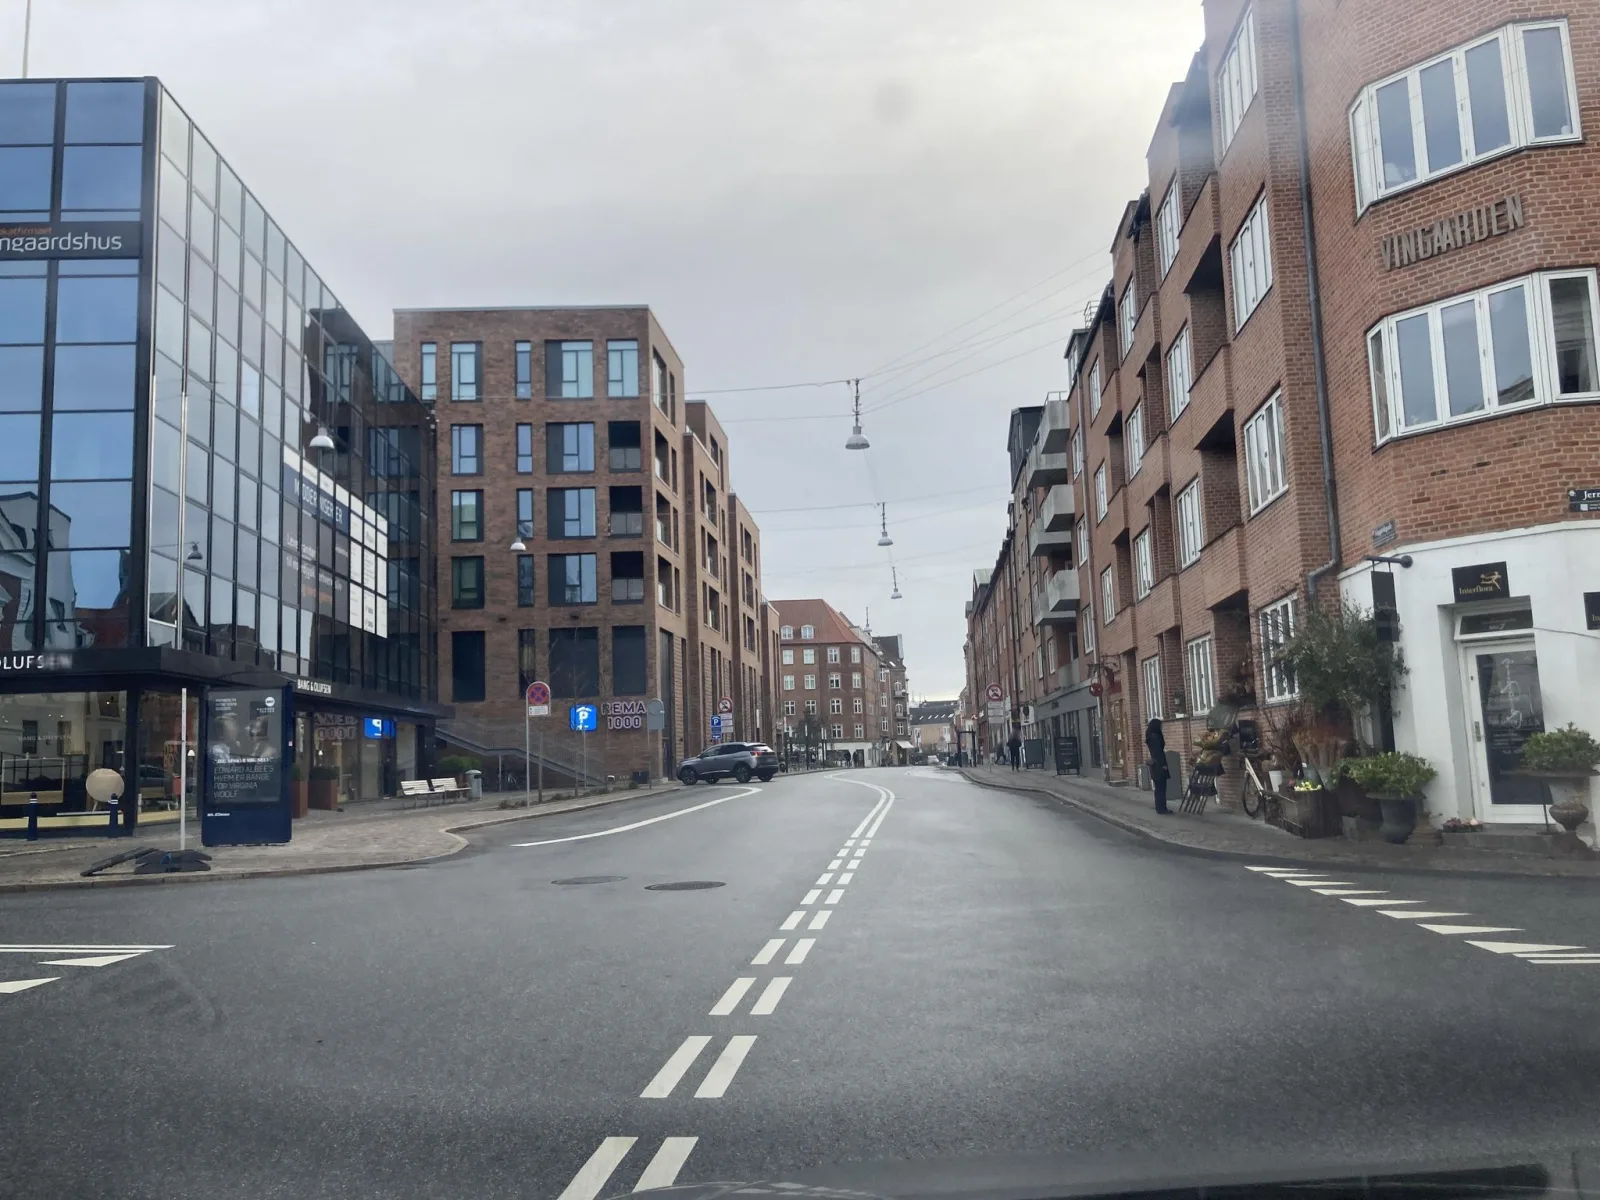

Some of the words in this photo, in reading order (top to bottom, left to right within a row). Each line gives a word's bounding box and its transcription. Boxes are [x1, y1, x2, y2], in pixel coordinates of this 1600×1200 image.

[1381, 193, 1524, 272] VINGAARDEN
[1459, 585, 1493, 594] Interflora
[298, 679, 310, 691] BANG
[314, 682, 332, 694] OLUFSEN
[601, 701, 647, 715] REMA
[608, 716, 641, 729] 1000
